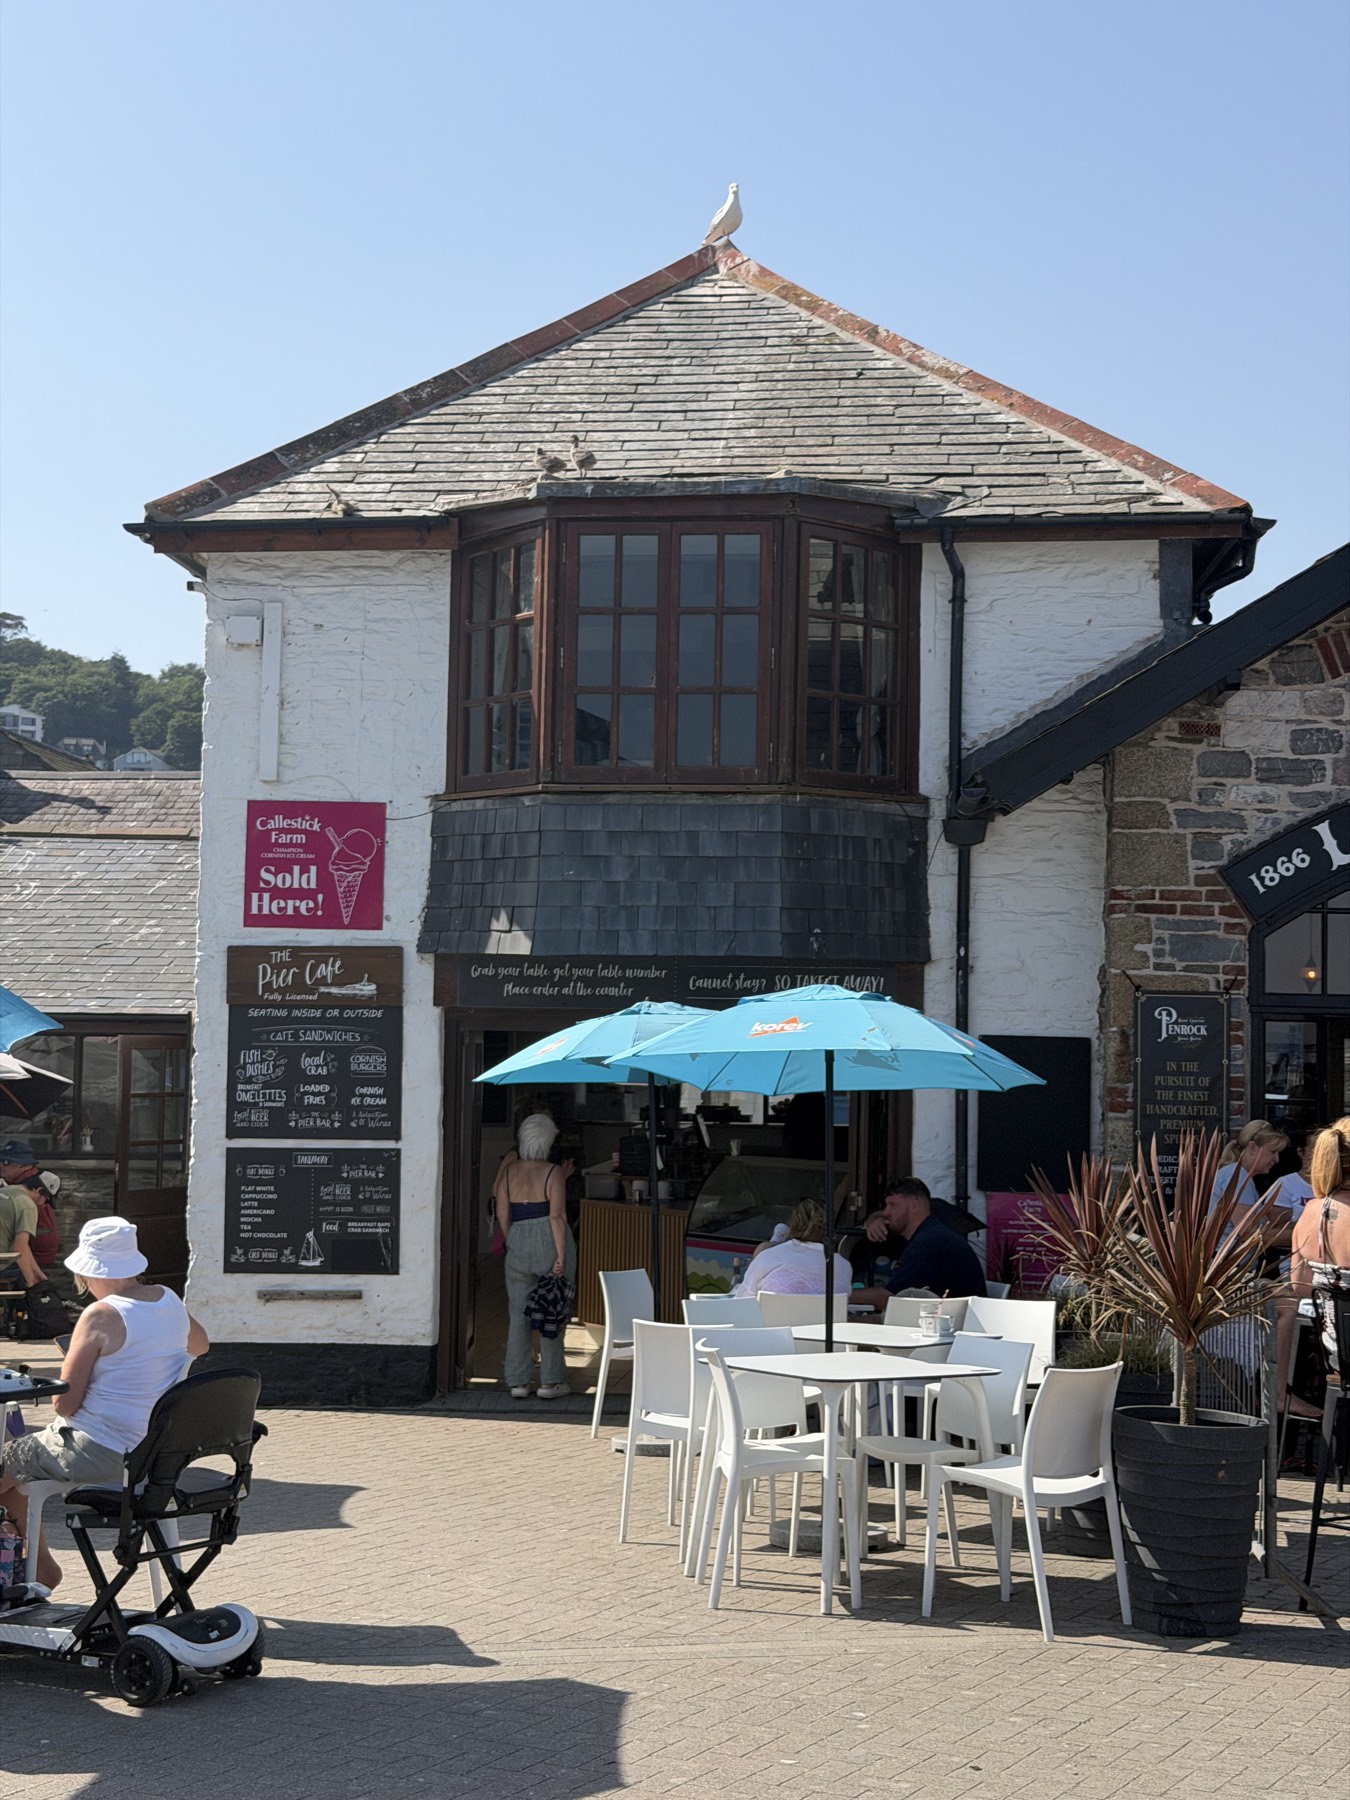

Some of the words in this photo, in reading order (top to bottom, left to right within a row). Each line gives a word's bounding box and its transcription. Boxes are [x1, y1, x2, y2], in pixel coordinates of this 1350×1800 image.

[256, 814, 321, 832] Callestick
[271, 831, 306, 843] Farm
[1248, 848, 1311, 894] 1866
[259, 865, 317, 889] Sold
[250, 892, 324, 916] Here!
[269, 949, 292, 964] THE
[471, 963, 496, 978] Grab
[498, 966, 521, 979] your
[523, 962, 550, 978] table
[553, 962, 570, 981] get
[572, 966, 595, 979] your
[598, 963, 624, 978] table
[625, 965, 668, 978] number
[258, 963, 299, 995] Pier
[689, 972, 734, 991] Cannot
[735, 972, 767, 993] stay?
[774, 975, 791, 991] SO
[843, 975, 884, 992] AWAY!
[504, 982, 532, 997] Place
[533, 983, 560, 996] order
[561, 981, 575, 995] at
[576, 981, 594, 995] the
[595, 981, 634, 996] counter
[264, 993, 282, 1002] Fully
[286, 993, 318, 1001] Licensed
[248, 1008, 288, 1017] SEATING
[292, 1008, 323, 1017] INSIDE
[326, 1009, 339, 1017] OR
[344, 1009, 384, 1017] OUTSIDE
[750, 1021, 813, 1031] korev
[1154, 1006, 1207, 1042] PENROCK
[270, 1030, 294, 1041] CAFE
[299, 1030, 361, 1042] SANDWICHES
[240, 1050, 261, 1064] FISH
[350, 1055, 387, 1063] CORNISH
[246, 1061, 274, 1077] DISHES
[306, 1066, 328, 1075] CRAB
[351, 1063, 387, 1071] BURGERS
[1166, 1062, 1177, 1071] IN
[1181, 1062, 1200, 1072] THE
[1154, 1076, 1195, 1086] PURSUIT
[1198, 1077, 1212, 1087] OF
[300, 1084, 330, 1092] LOADED
[355, 1086, 384, 1095] CORNISH
[236, 1090, 287, 1102] OMELETTES
[304, 1095, 325, 1105] FRIES
[351, 1097, 361, 1105] ICE
[363, 1097, 387, 1105] CREAM
[1156, 1091, 1175, 1100] THE
[1178, 1091, 1209, 1101] FINEST
[251, 1113, 269, 1121] BEER
[298, 1118, 315, 1128] PIER
[317, 1118, 331, 1128] BAR
[297, 1155, 329, 1164] TAKEAWAY
